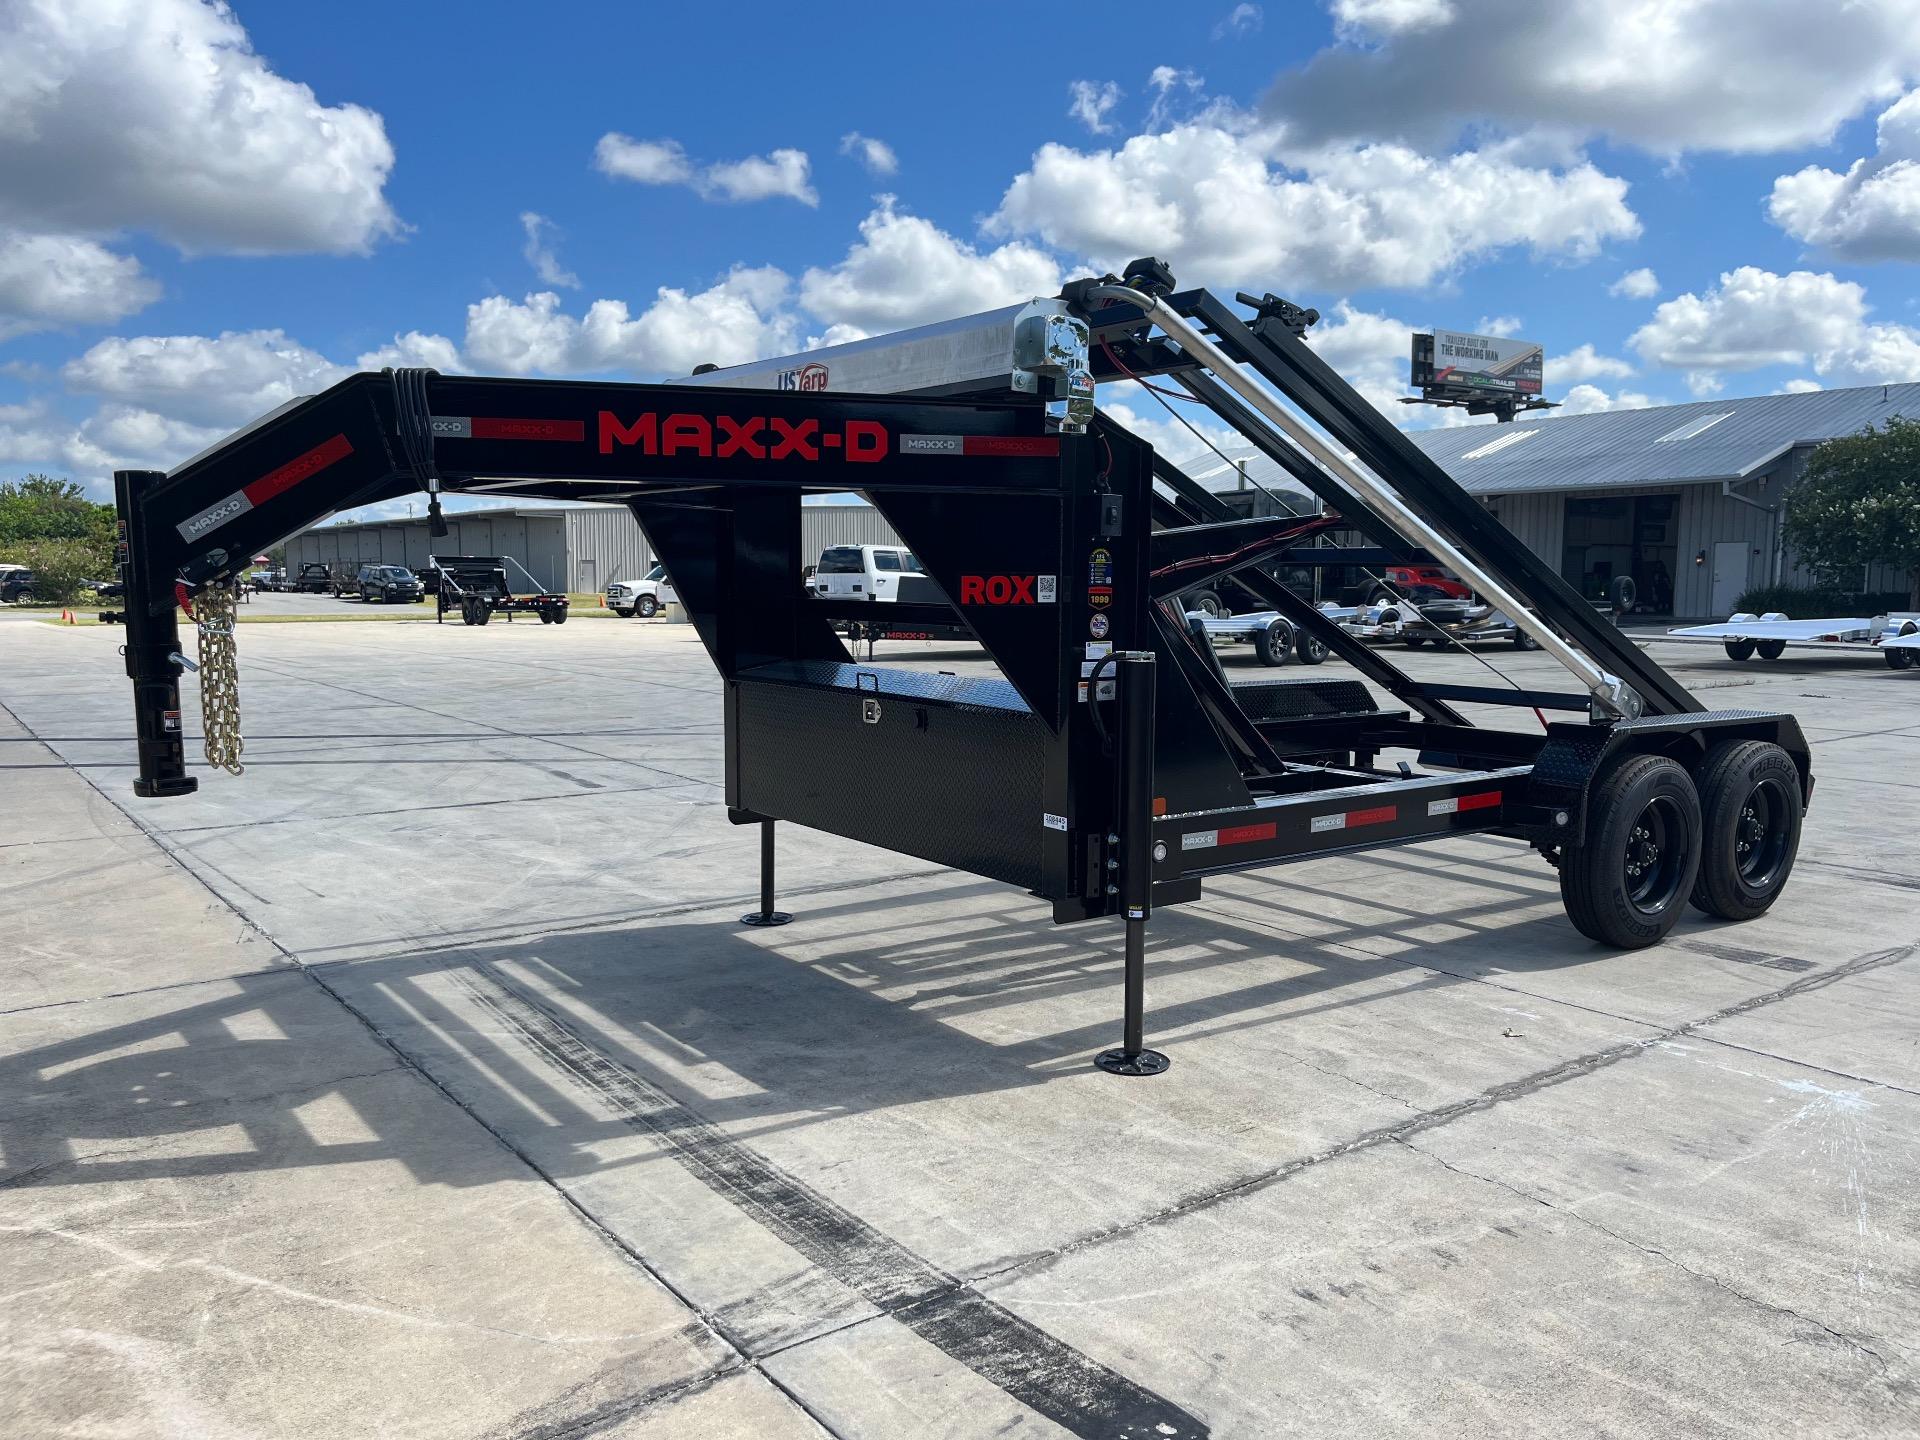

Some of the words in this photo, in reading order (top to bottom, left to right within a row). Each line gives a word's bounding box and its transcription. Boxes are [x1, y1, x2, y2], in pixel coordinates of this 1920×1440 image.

[1441, 344, 1454, 356] THE
[1454, 347, 1484, 360] WORKING
[1484, 350, 1499, 361] MAN
[598, 411, 888, 463] MAXX-D
[908, 440, 956, 449] MAXX-D
[271, 454, 323, 487] MAXX-D
[188, 500, 241, 534] MAXX-D
[961, 575, 1036, 605] ROX
[1090, 595, 1109, 604] 1999
[887, 631, 926, 640] MAXX-D
[1316, 818, 1342, 828] MAXX-D
[1184, 834, 1213, 845] MAXX-D
